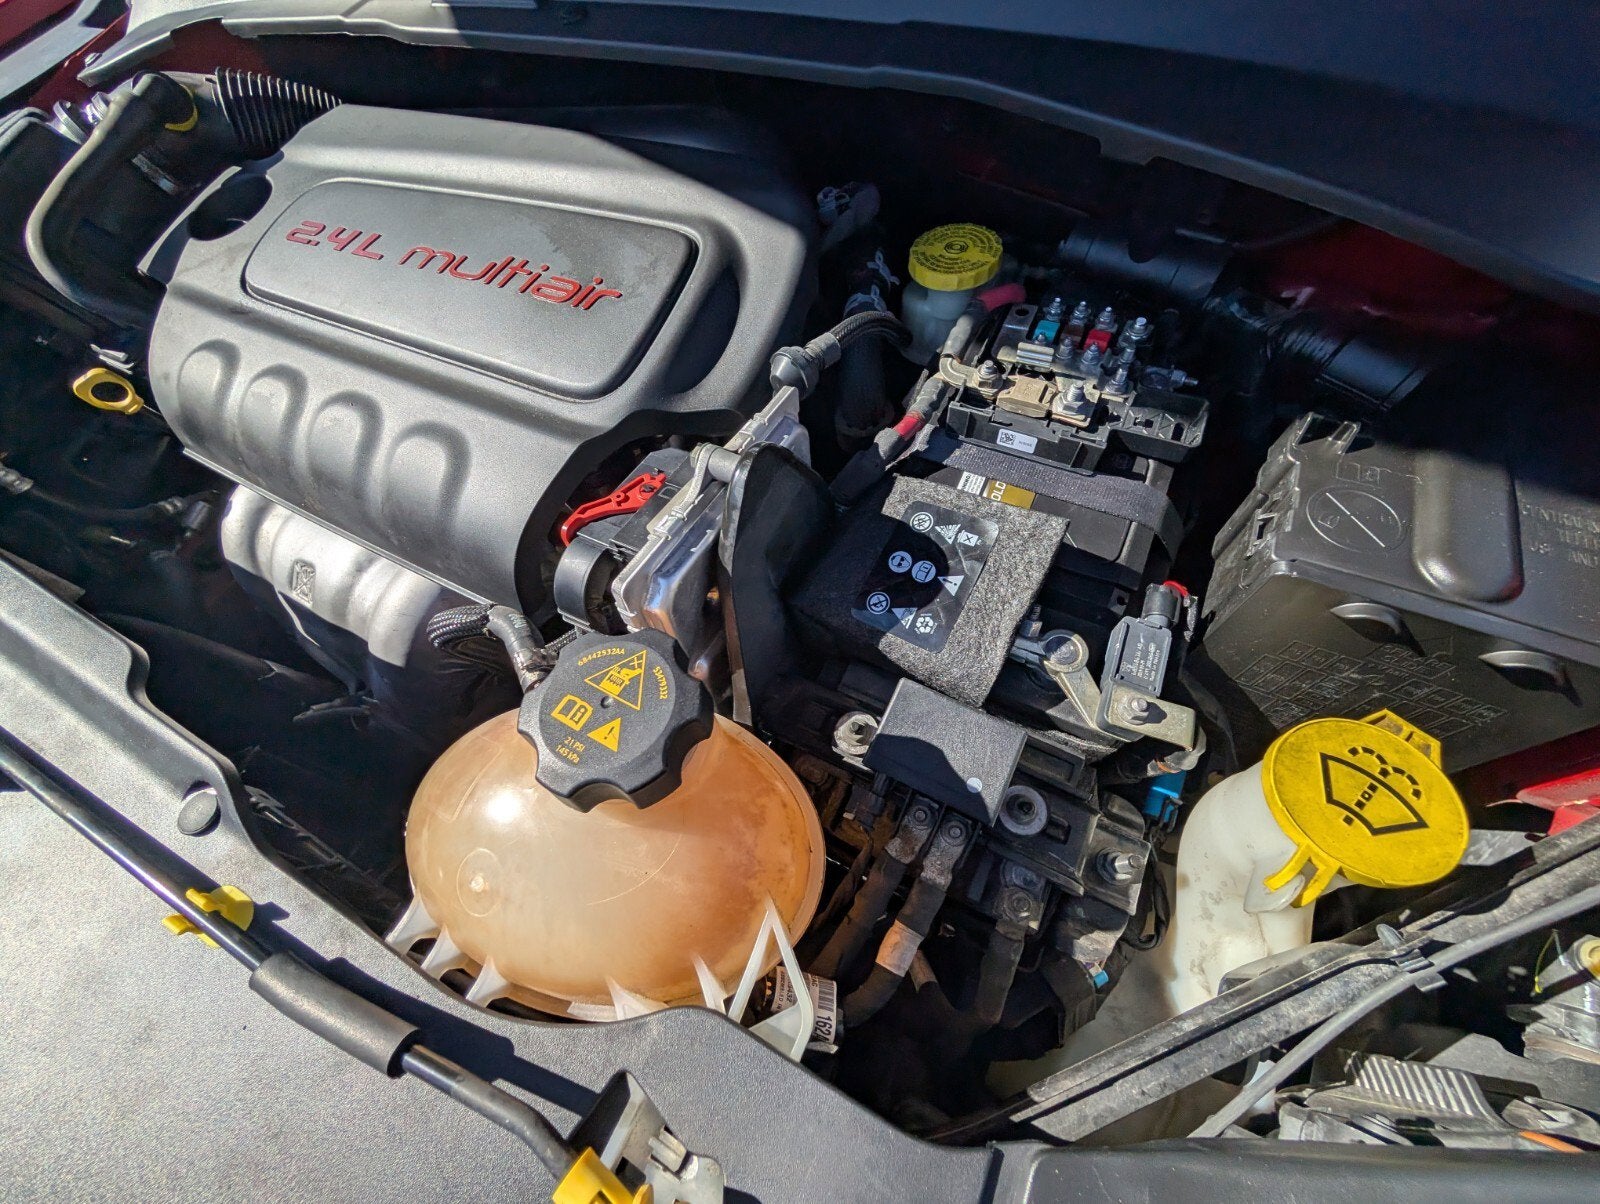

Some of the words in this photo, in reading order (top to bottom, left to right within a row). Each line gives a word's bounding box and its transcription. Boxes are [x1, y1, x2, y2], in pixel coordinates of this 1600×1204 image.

[285, 220, 384, 260] 2.4L
[399, 246, 622, 310] multiair
[990, 481, 1007, 502] OLD
